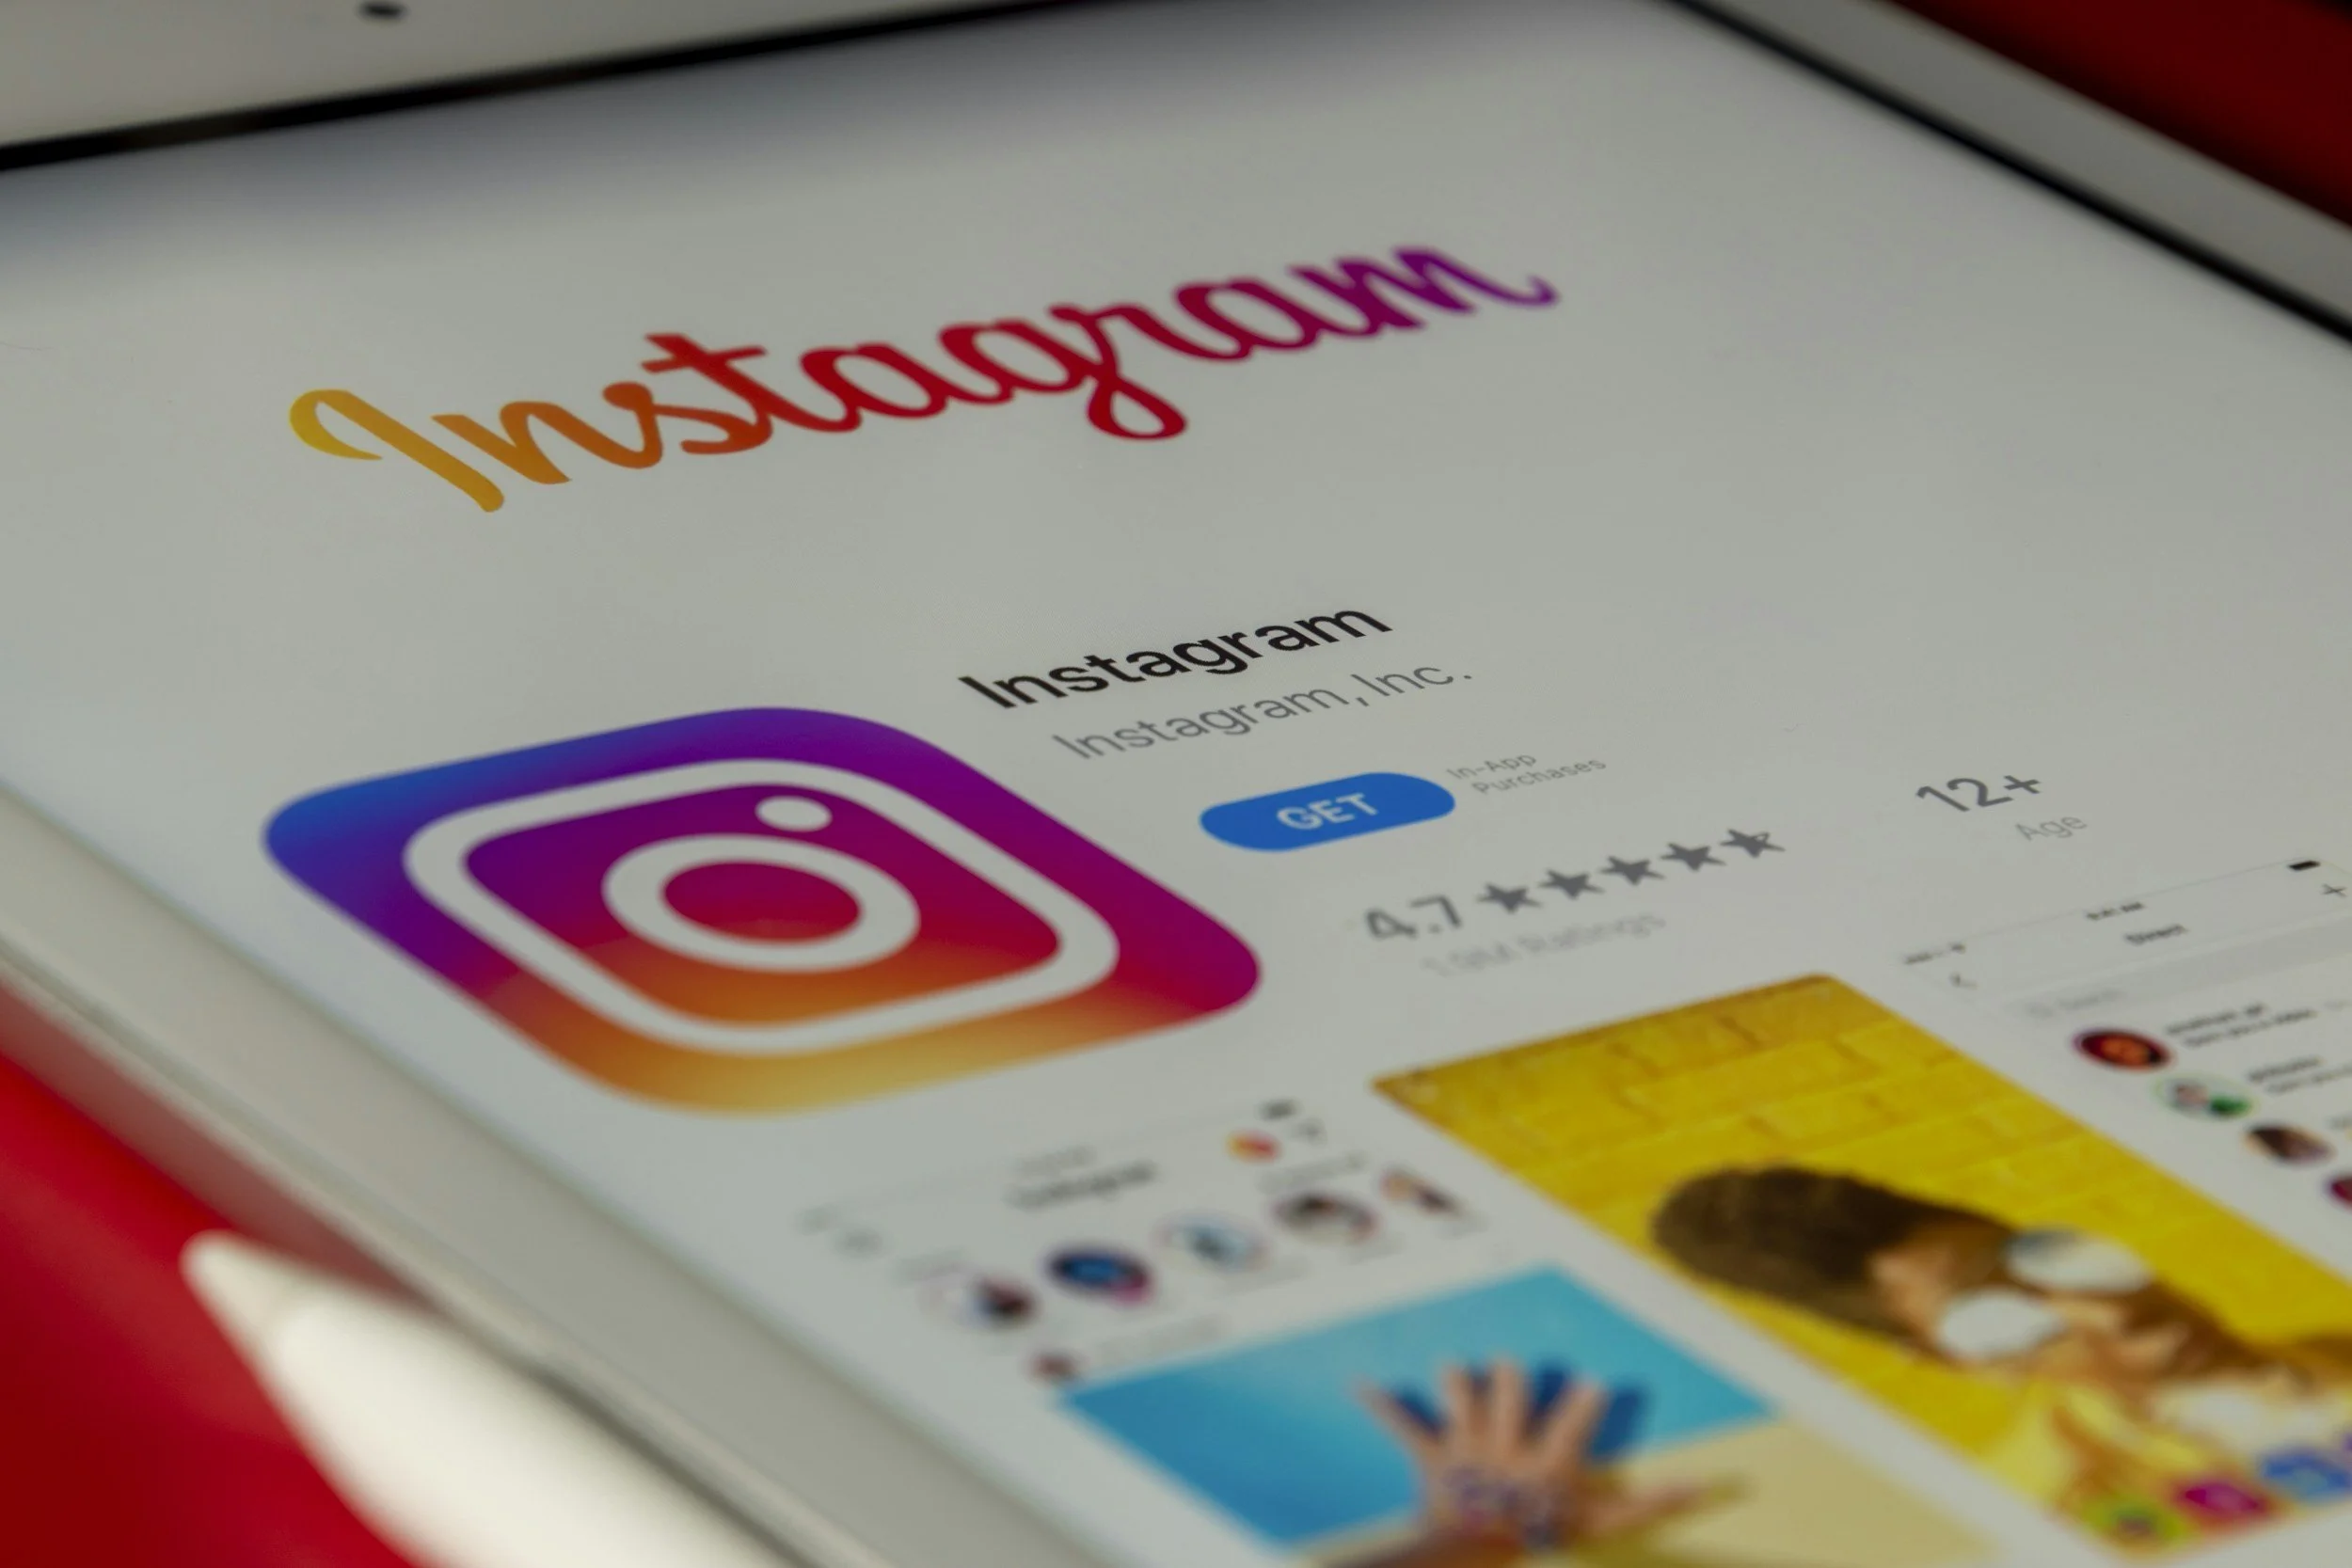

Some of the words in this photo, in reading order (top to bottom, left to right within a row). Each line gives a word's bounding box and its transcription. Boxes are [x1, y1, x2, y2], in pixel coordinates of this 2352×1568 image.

[287, 245, 1560, 514] Instagram
[958, 609, 1393, 709] Instagram
[1051, 688, 1370, 760] Instagram,
[1349, 664, 1473, 698] Inc.
[1445, 752, 1537, 782] In-App
[1470, 757, 1608, 795] Purchases
[1275, 792, 1381, 832] GET
[1915, 775, 2042, 813] 12+
[2014, 815, 2089, 842] Age
[1363, 894, 1463, 942] 4.7
[1516, 912, 1667, 954] Ratings
